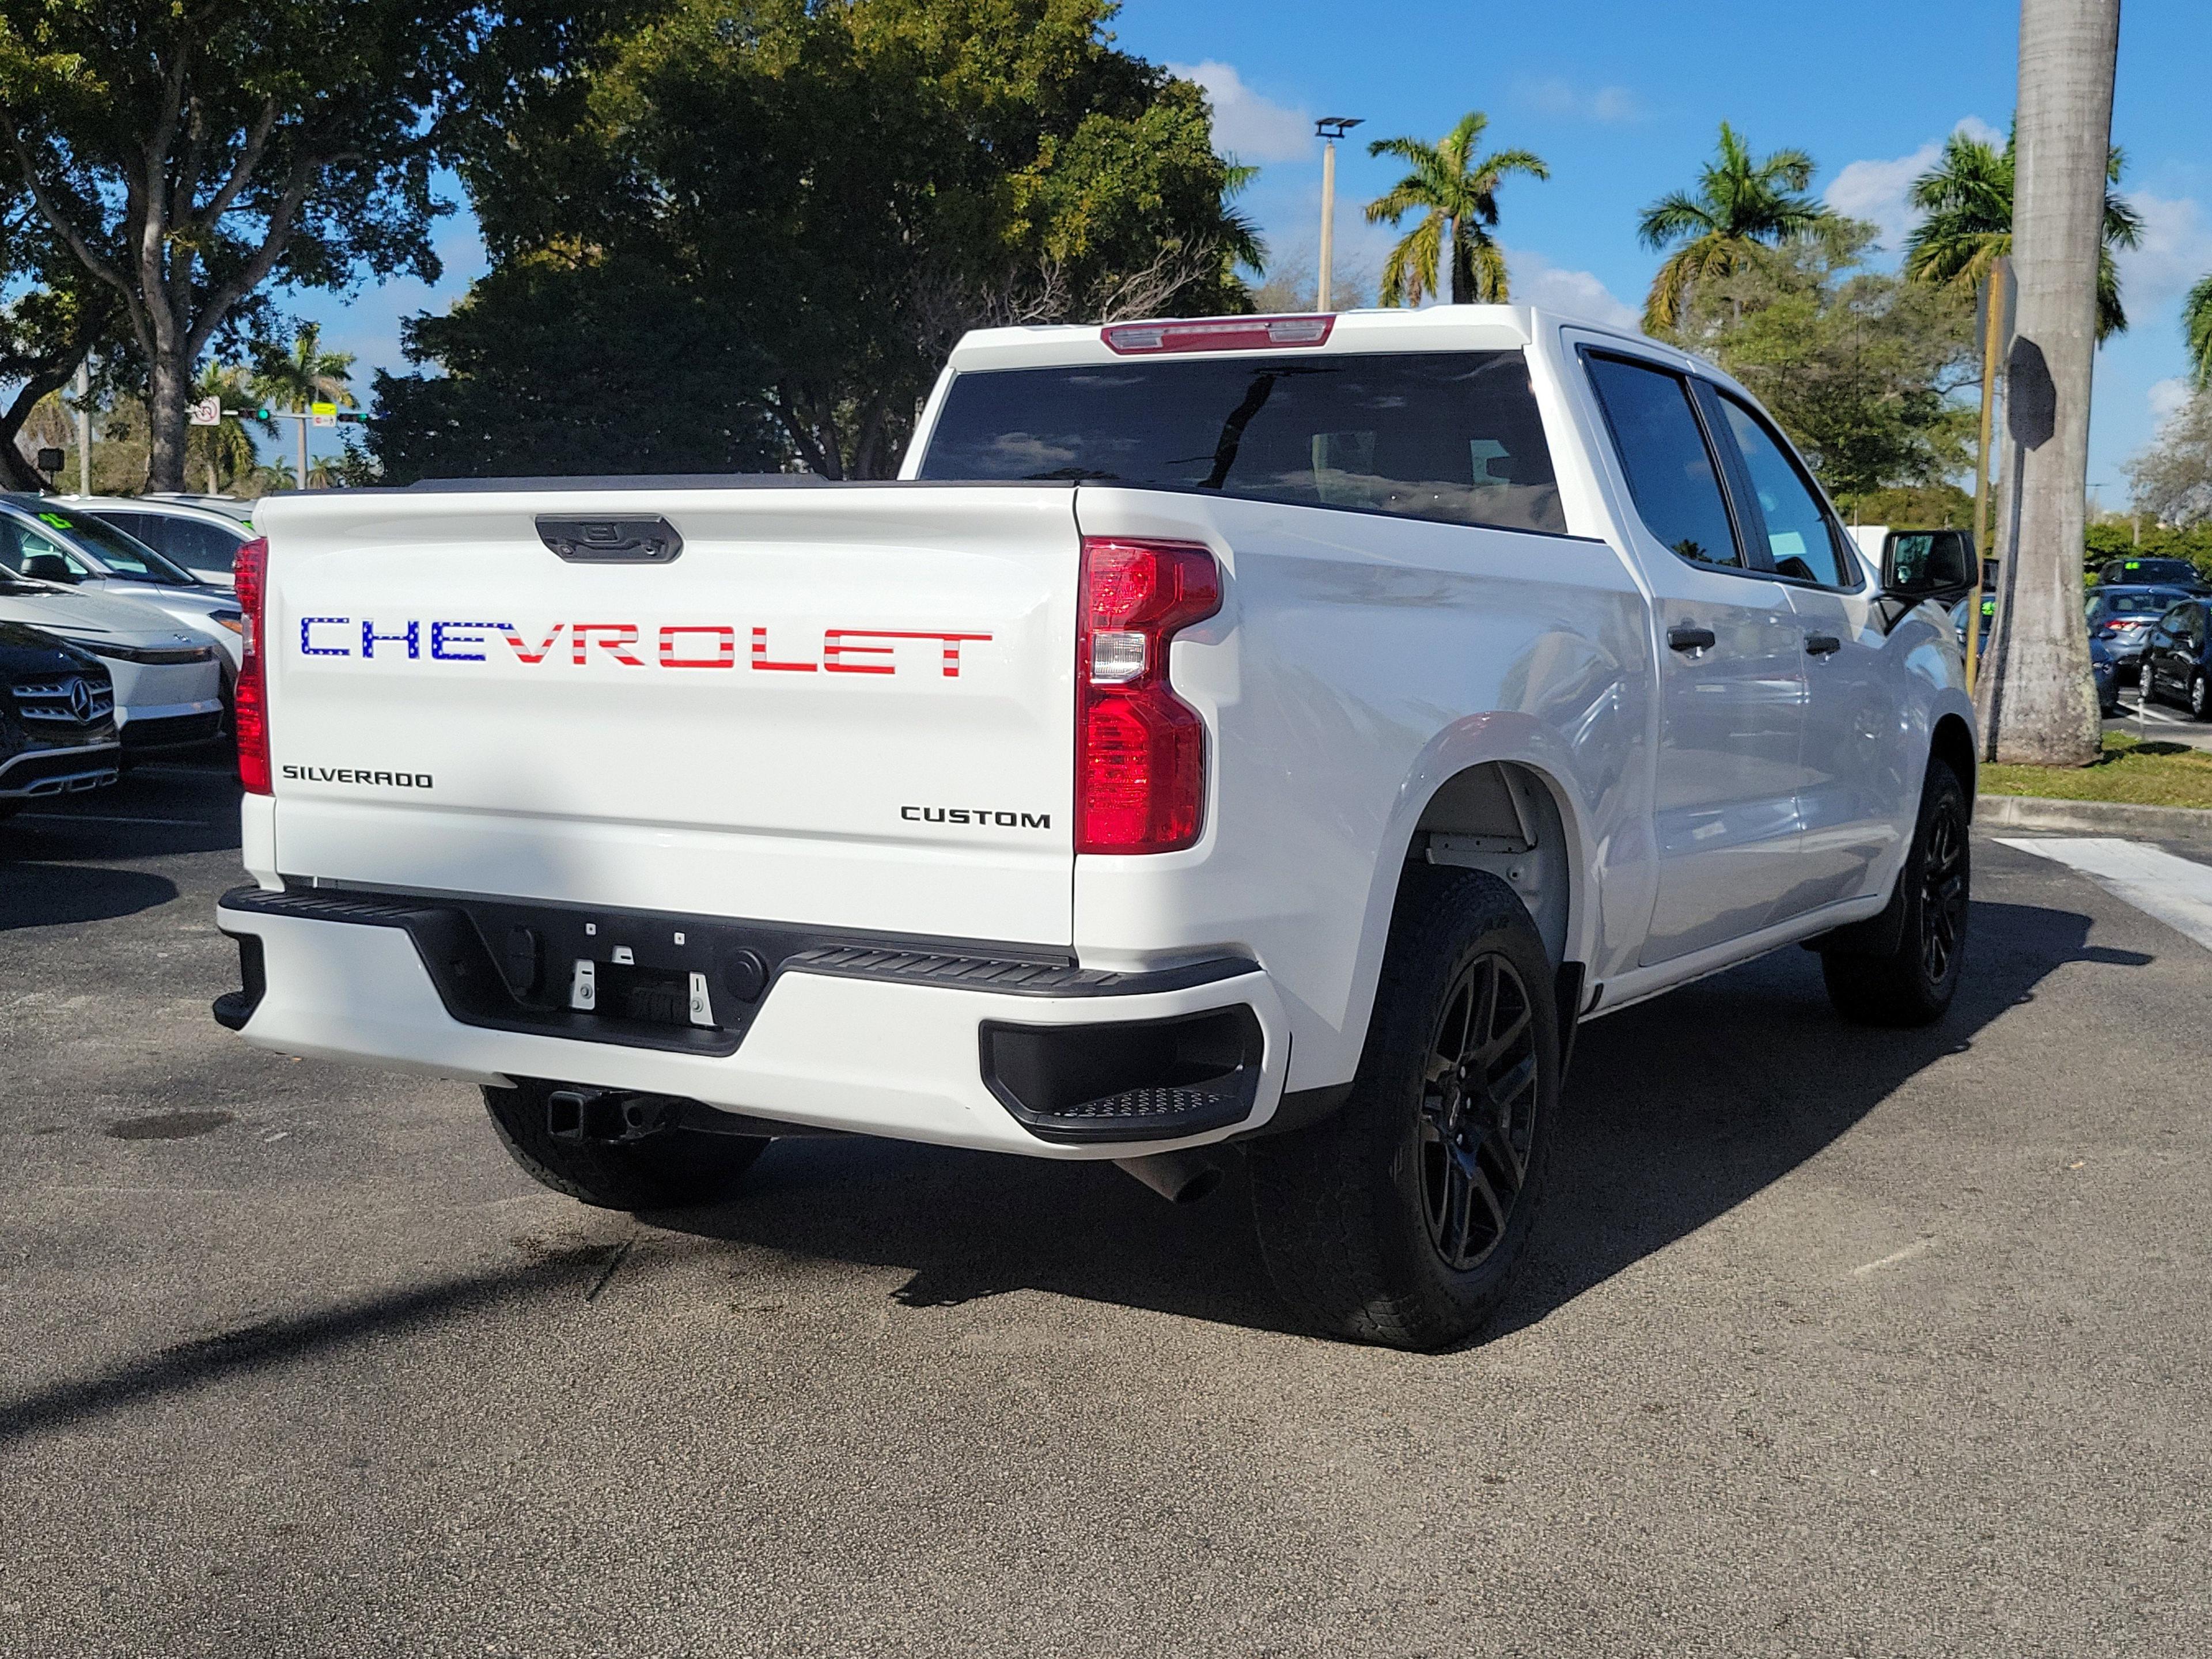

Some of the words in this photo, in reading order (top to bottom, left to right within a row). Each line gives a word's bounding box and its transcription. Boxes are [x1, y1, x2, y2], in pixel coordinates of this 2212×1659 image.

[301, 617, 993, 677] CHEVROLET
[283, 765, 433, 788] SILVERADO
[900, 806, 1051, 830] CUSTOM
